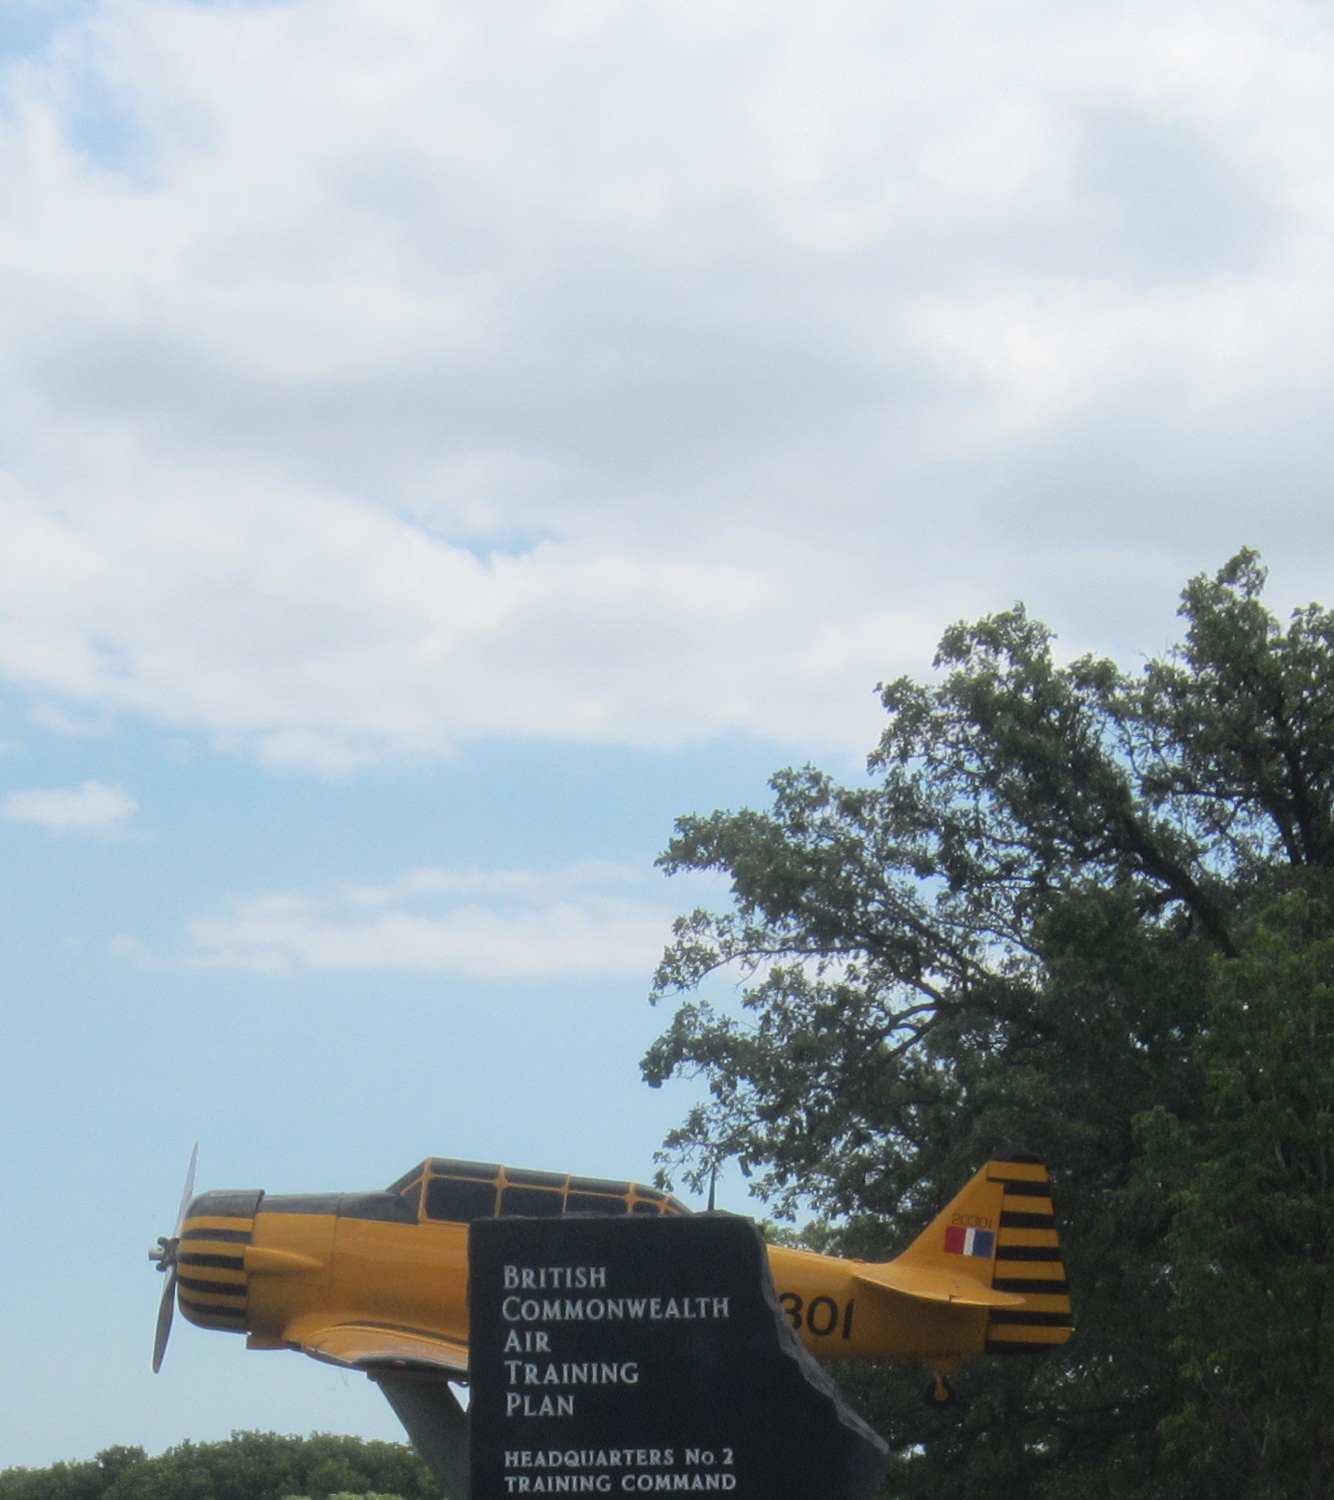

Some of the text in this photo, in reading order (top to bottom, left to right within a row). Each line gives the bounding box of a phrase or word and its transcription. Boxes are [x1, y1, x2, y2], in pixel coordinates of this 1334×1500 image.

[951, 1213, 992, 1230] 20301
[504, 1265, 607, 1289] BRITISH
[502, 1296, 730, 1322] COMMONWEALTH
[503, 1328, 552, 1352] AIR
[504, 1360, 640, 1385] TRAINING
[506, 1392, 575, 1417] PLAN
[504, 1449, 675, 1467] HEADQUARTERS
[723, 1448, 734, 1465] 2
[504, 1473, 737, 1493] TRAINING COMMAND
